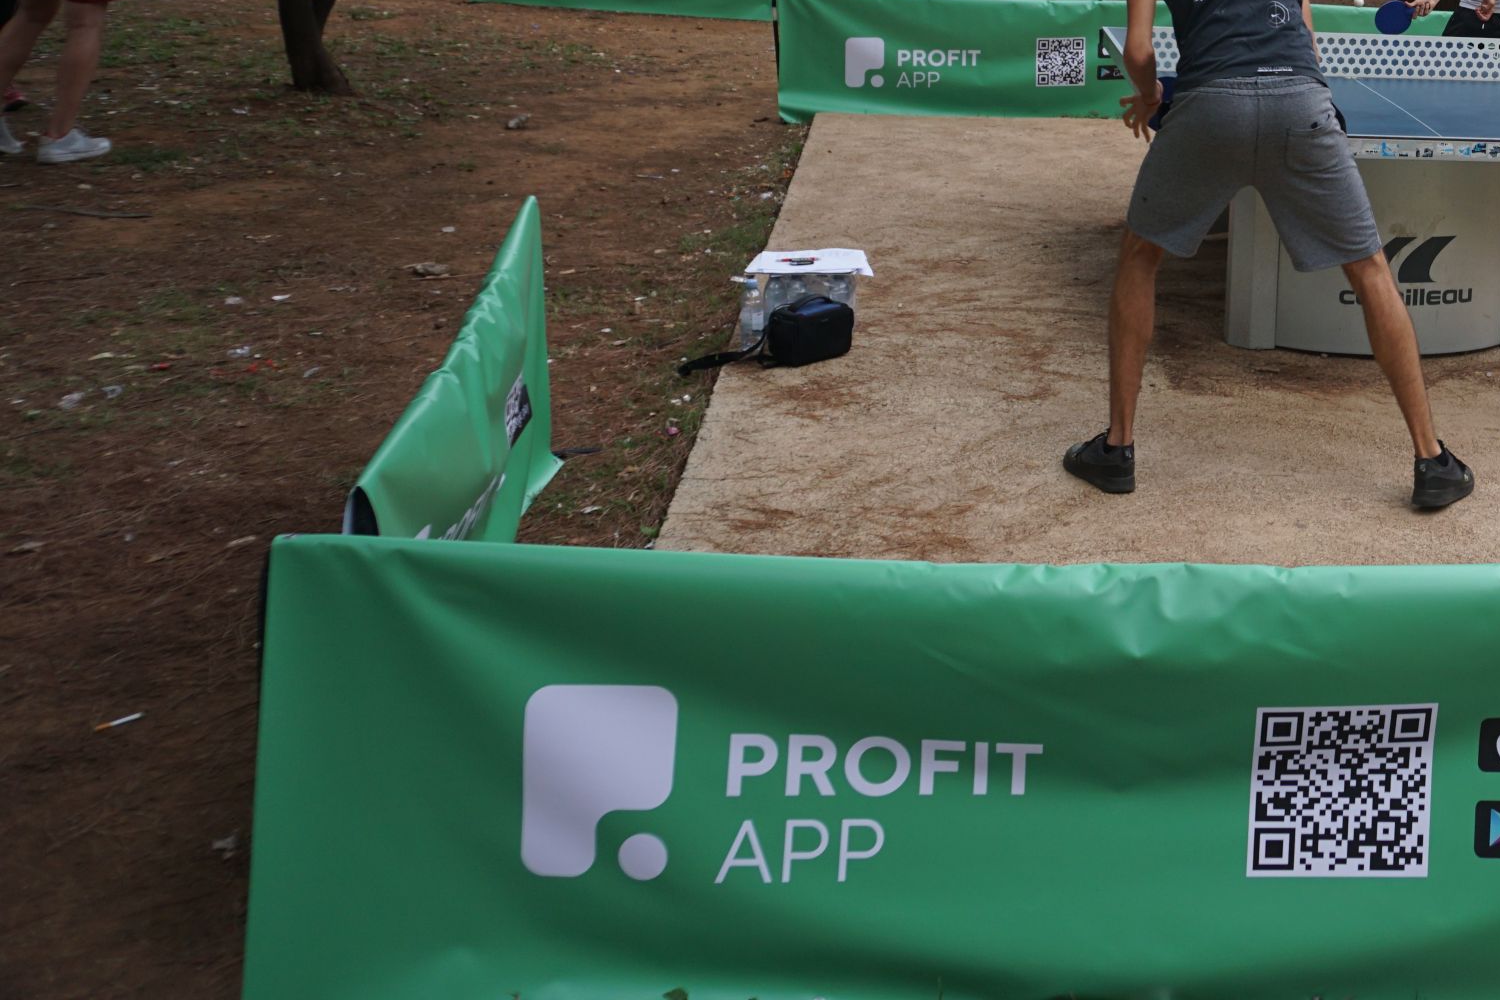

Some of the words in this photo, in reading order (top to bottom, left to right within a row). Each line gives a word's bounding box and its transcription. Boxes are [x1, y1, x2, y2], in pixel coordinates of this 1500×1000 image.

[897, 50, 981, 67] PROFIT
[896, 71, 941, 89] APP
[725, 732, 1044, 798] PROFIT
[714, 818, 886, 884] APP
